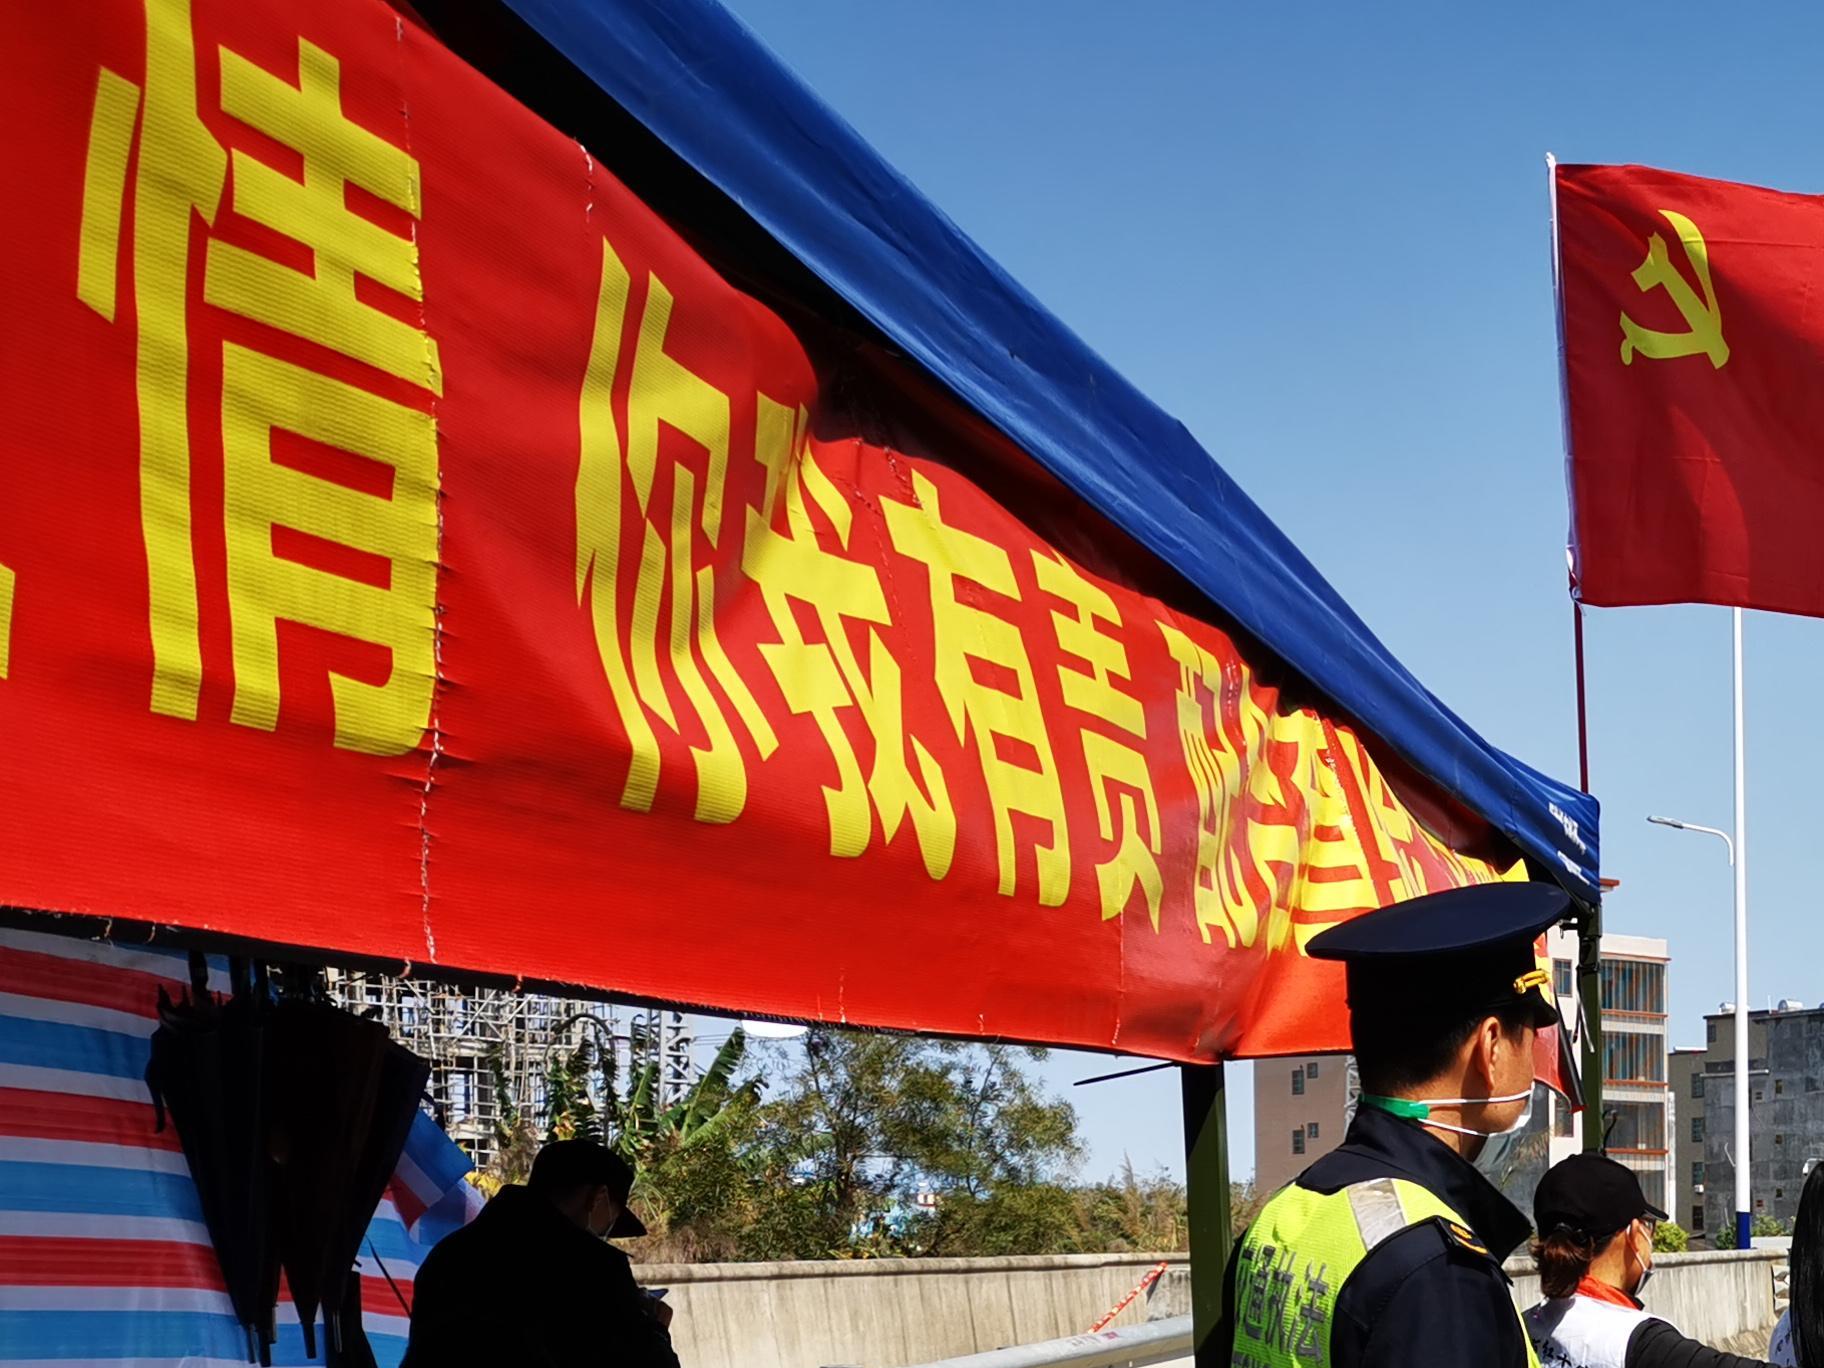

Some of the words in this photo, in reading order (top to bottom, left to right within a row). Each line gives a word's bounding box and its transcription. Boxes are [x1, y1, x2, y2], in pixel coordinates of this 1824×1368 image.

[0, 0, 443, 757] 情
[575, 236, 1164, 935] 你我有责
